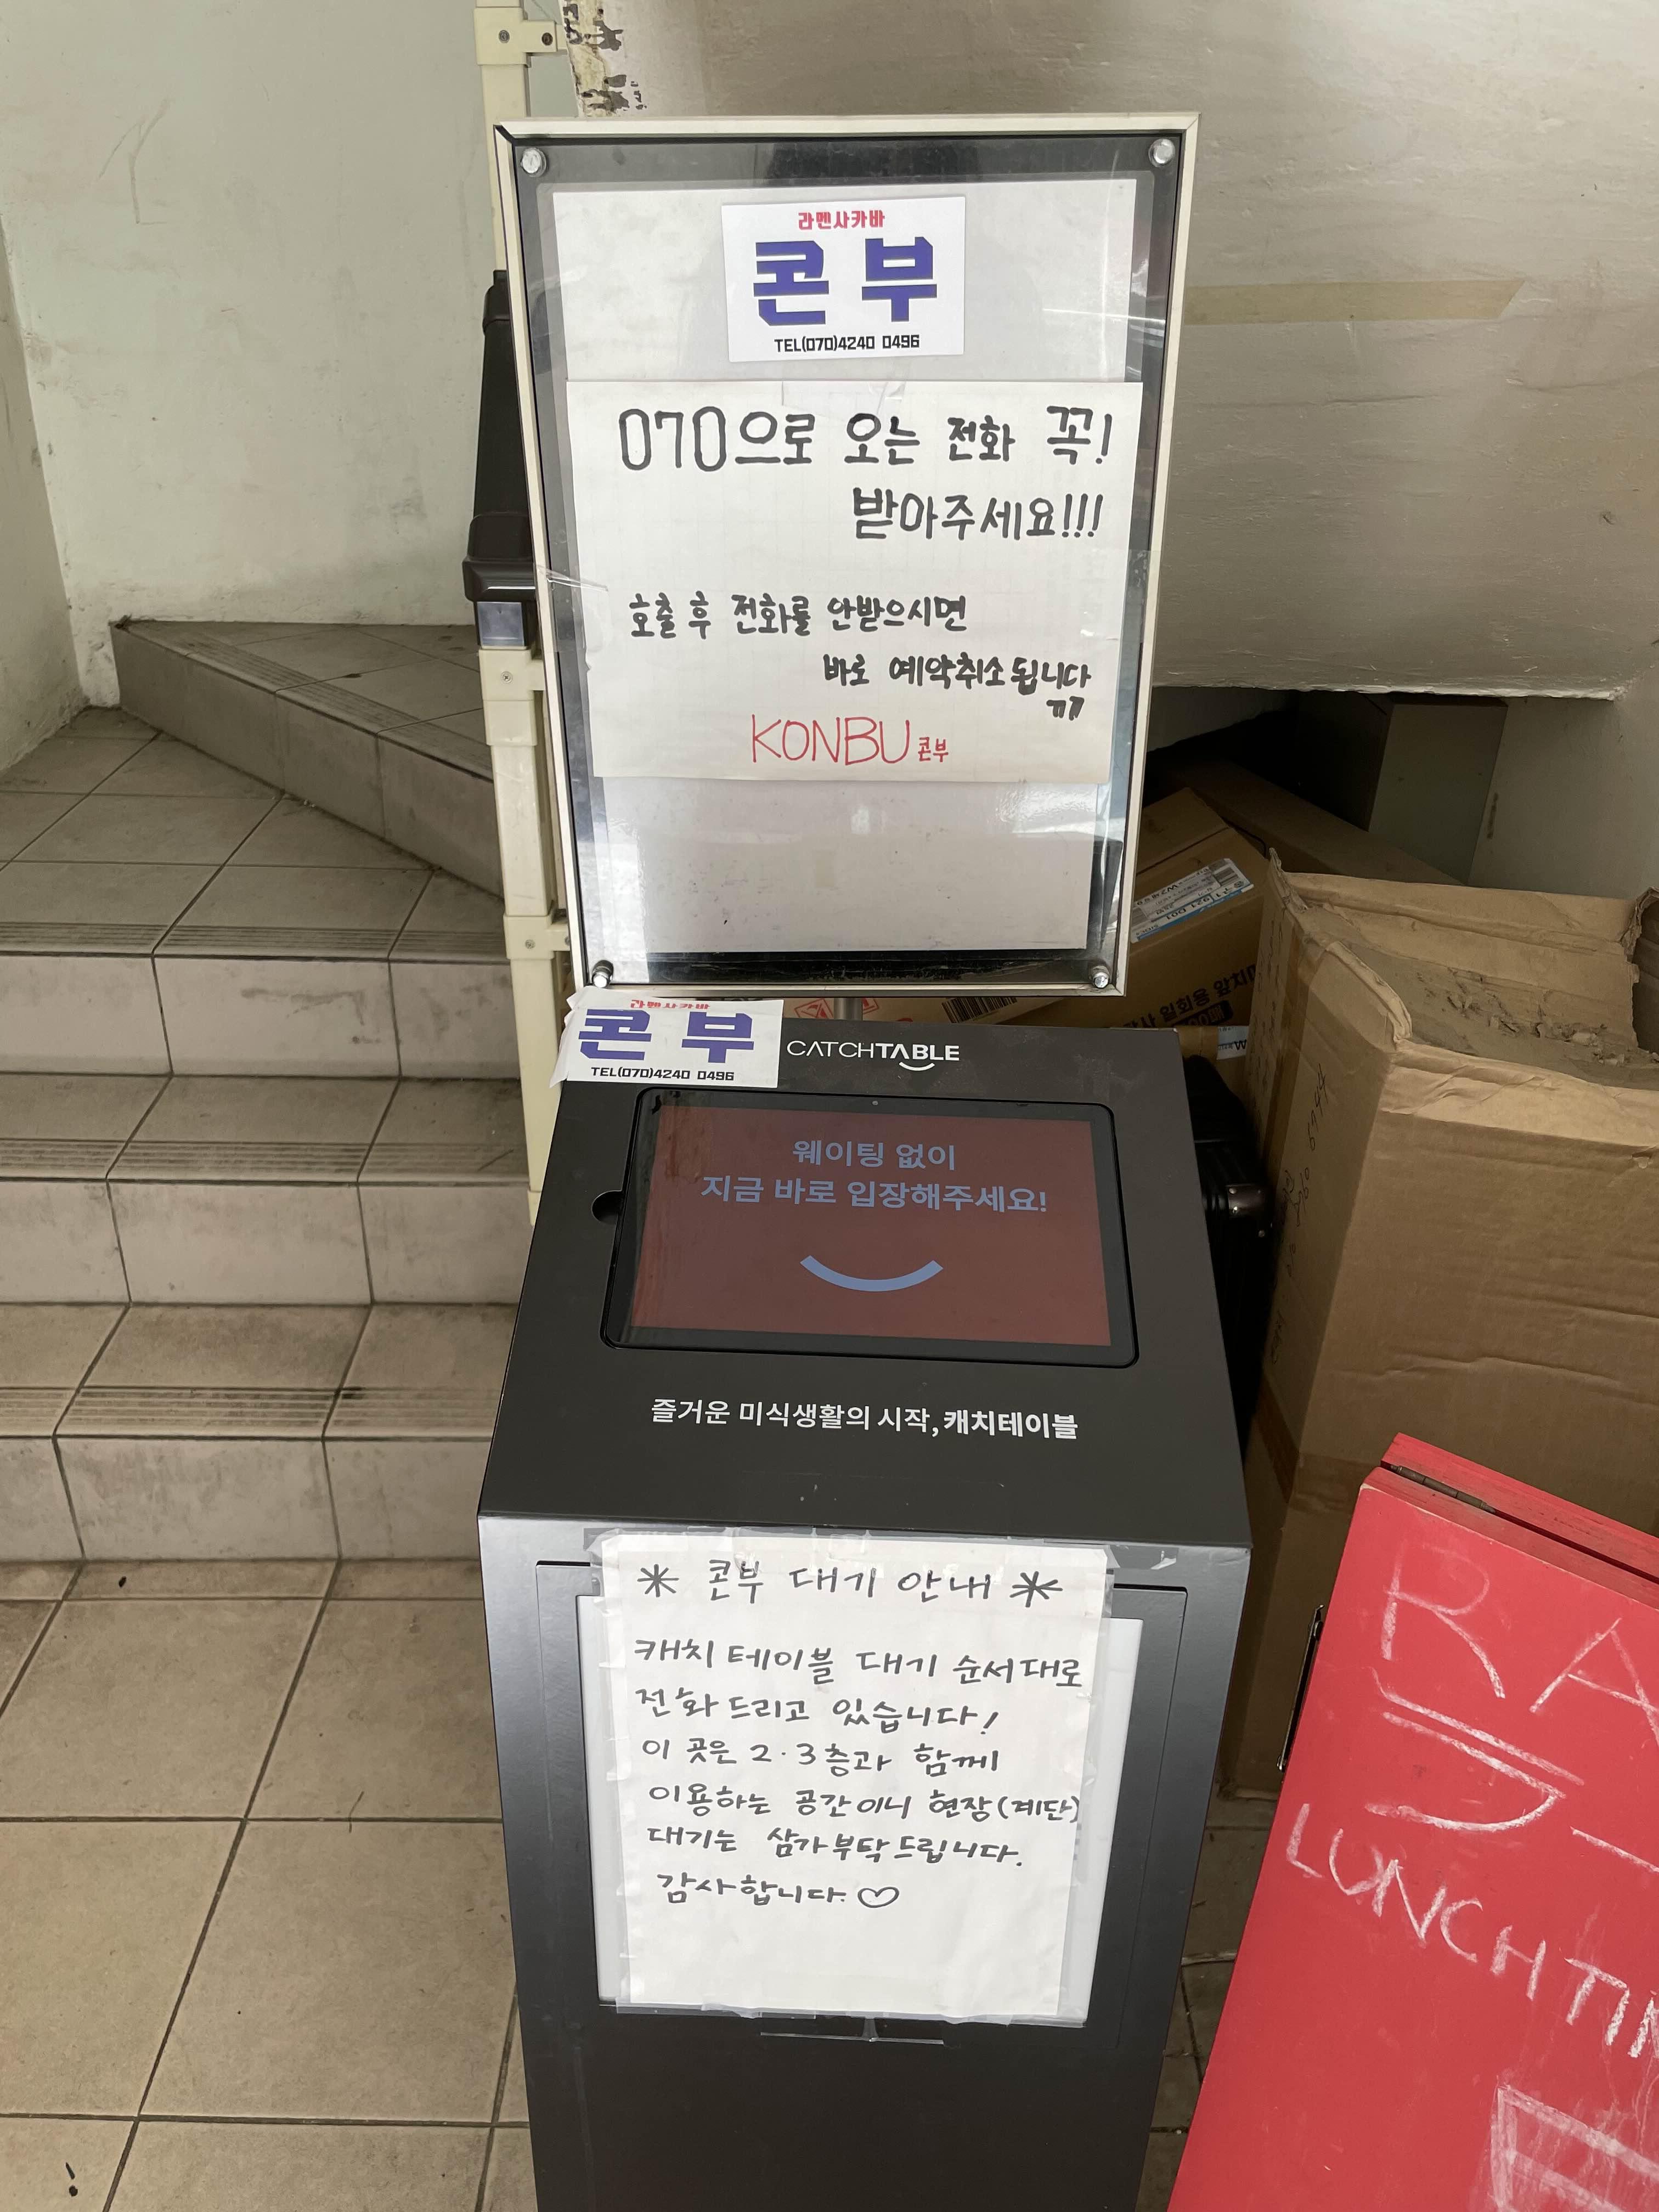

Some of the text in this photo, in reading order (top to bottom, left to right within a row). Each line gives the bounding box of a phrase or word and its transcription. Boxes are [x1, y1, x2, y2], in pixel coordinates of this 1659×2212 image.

[798, 210, 885, 230] 라멘사카바
[774, 334, 919, 352] TEL(070)4240 0496
[618, 405, 1113, 472] 070으로 오는 전화 꼭!
[853, 487, 1104, 541] 받아주세요!!!
[731, 592, 811, 636] 전화를
[827, 595, 967, 633] 안받으시면
[822, 653, 870, 686] 바로
[752, 714, 949, 766] KONBU 콘부
[787, 1040, 960, 1061] CATCHTABLE
[591, 1066, 735, 1081] TEL(070)4240 0496
[792, 1140, 955, 1171] 웨이팅 없이
[701, 1175, 1047, 1213] 지금 바로 입장해주세요!
[651, 1398, 730, 1424] 즐거운
[740, 1402, 870, 1430] 미식생활의
[709, 1559, 991, 1604] 콘부 대기 안내
[855, 1651, 938, 1677] 대기
[952, 1655, 1082, 1688] 순서대로
[832, 1698, 999, 1735] 있습니다!
[913, 1743, 998, 1778] 함께
[649, 1783, 771, 1817] 이용하는
[647, 1826, 737, 1852] 대기는
[657, 1872, 847, 1906] 감사합니다.
